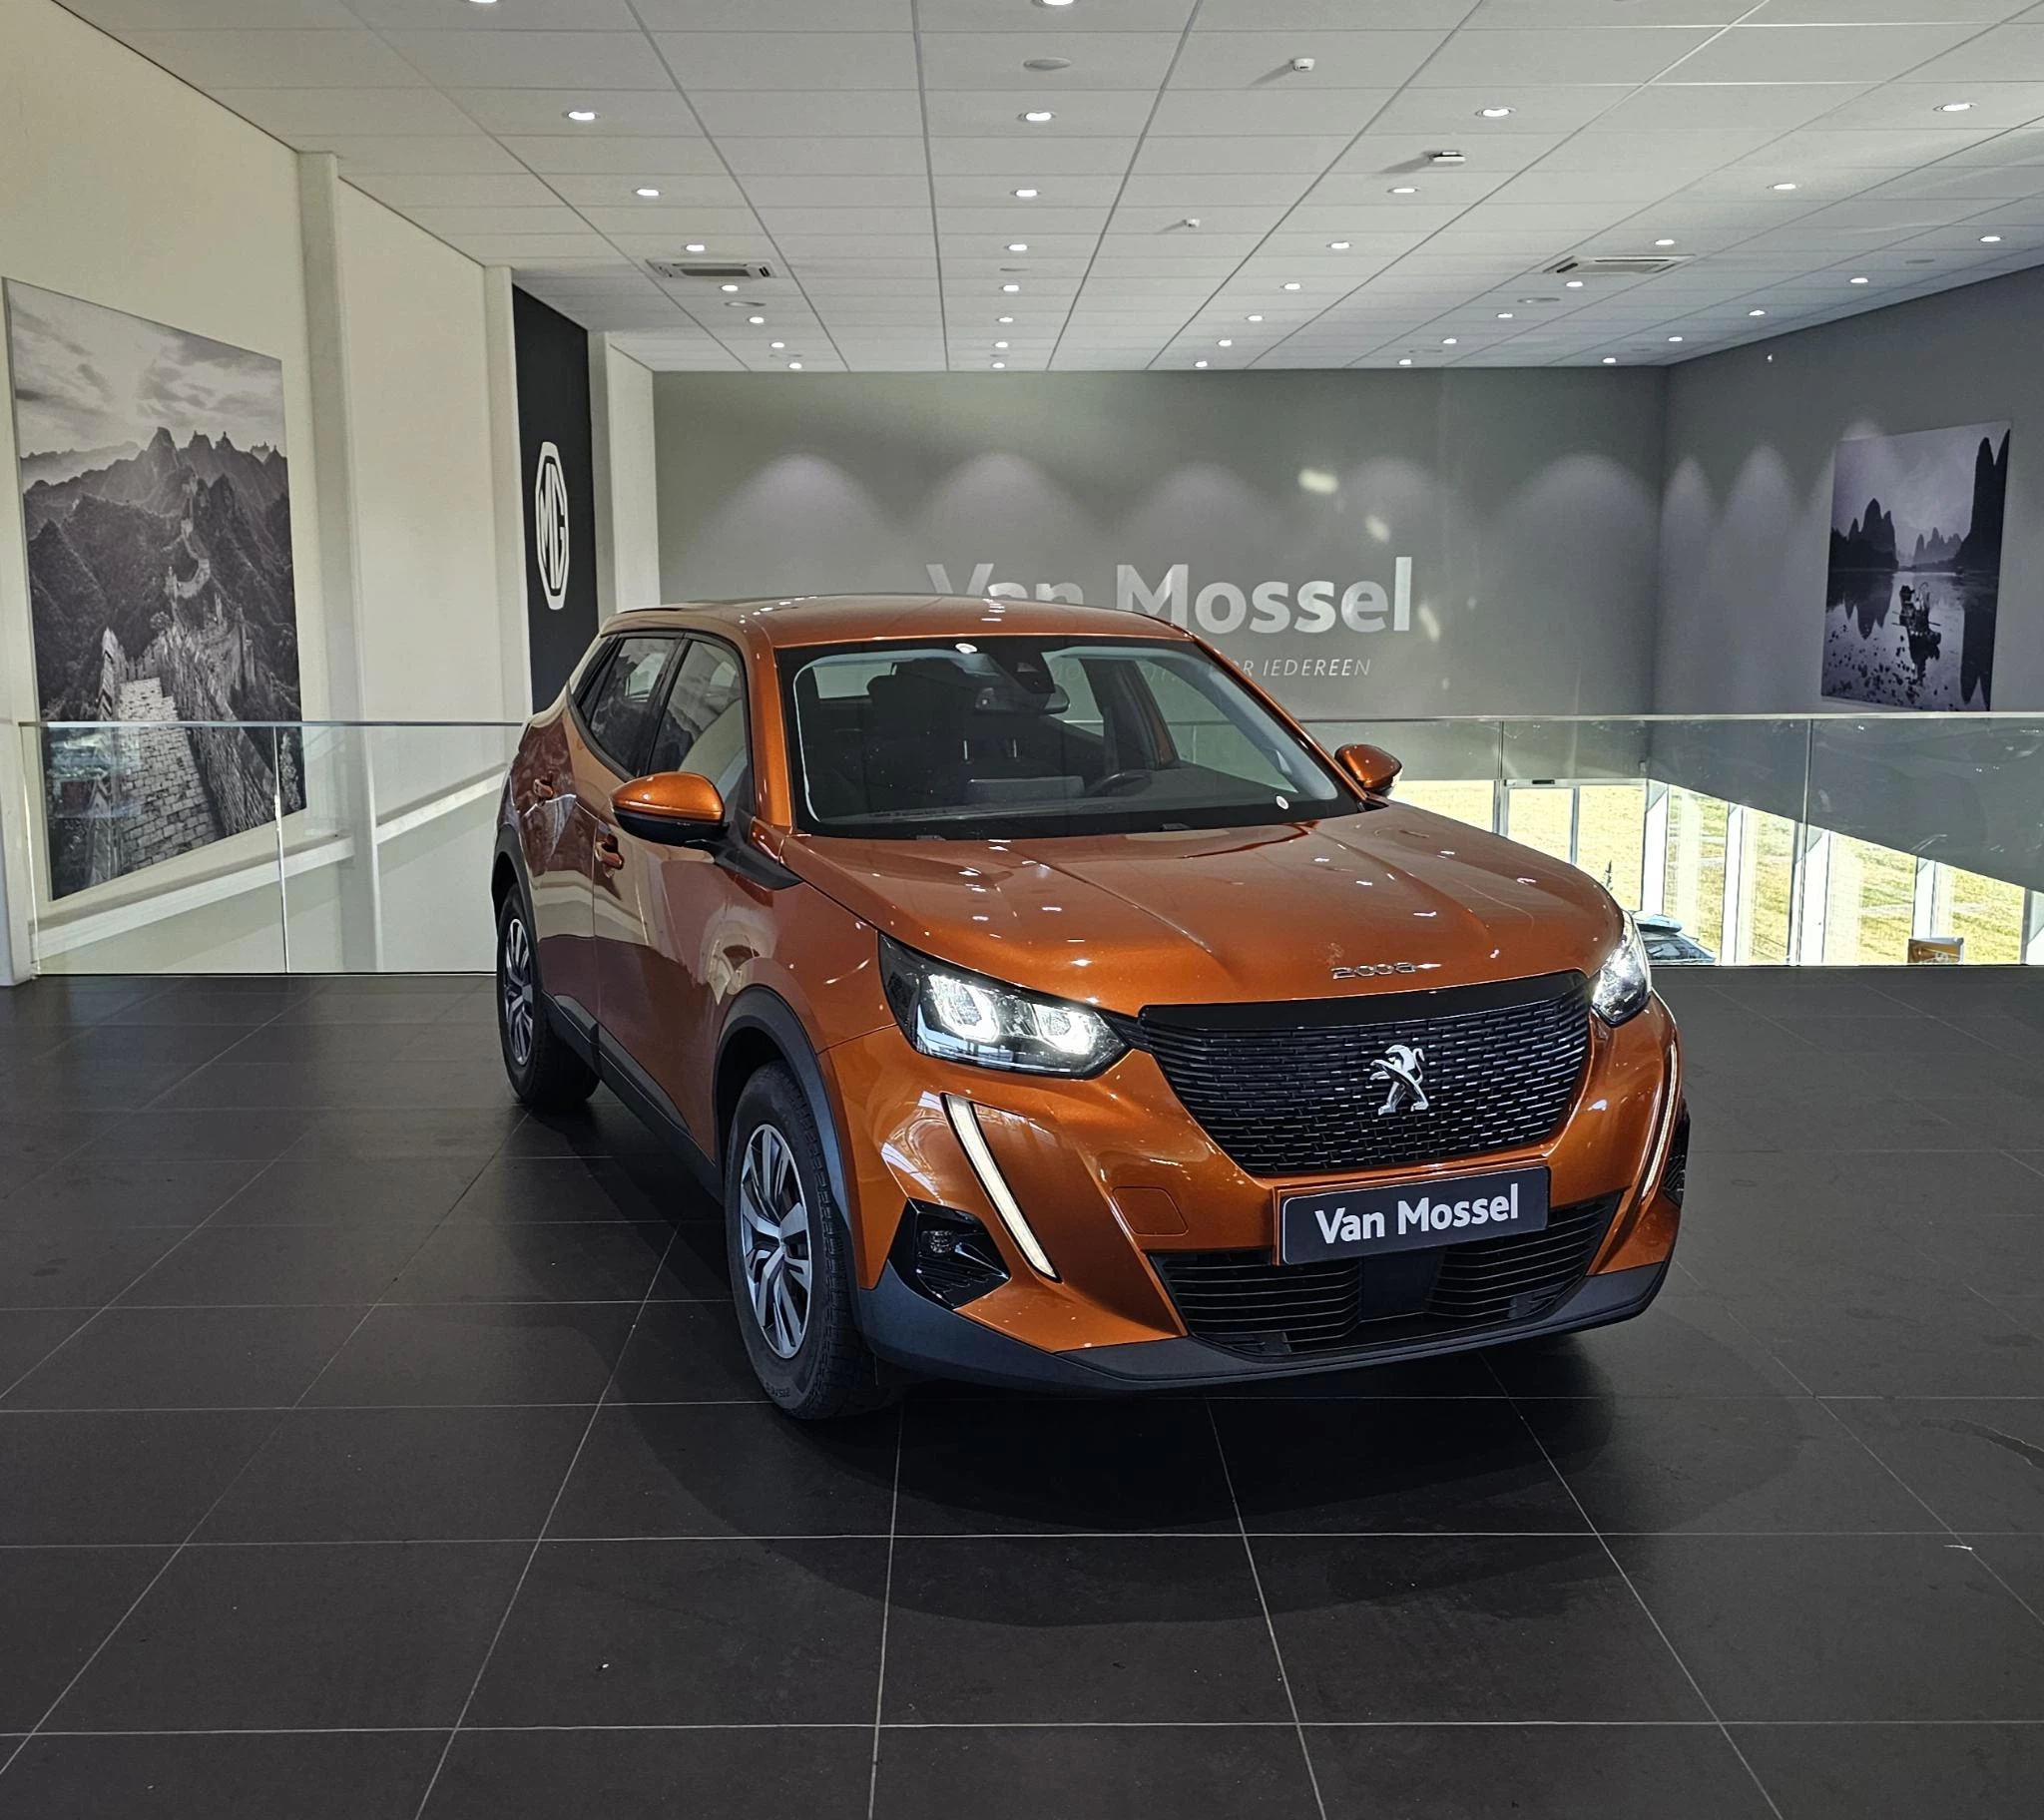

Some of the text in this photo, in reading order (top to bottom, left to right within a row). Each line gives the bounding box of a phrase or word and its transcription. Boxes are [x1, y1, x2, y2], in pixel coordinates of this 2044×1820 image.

[538, 461, 566, 592] MG
[1117, 557, 1411, 633] Mossel
[1263, 659, 1370, 677] IEDEREEN
[1330, 962, 1416, 979] 2008
[1314, 1183, 1518, 1244] Van Mossel
